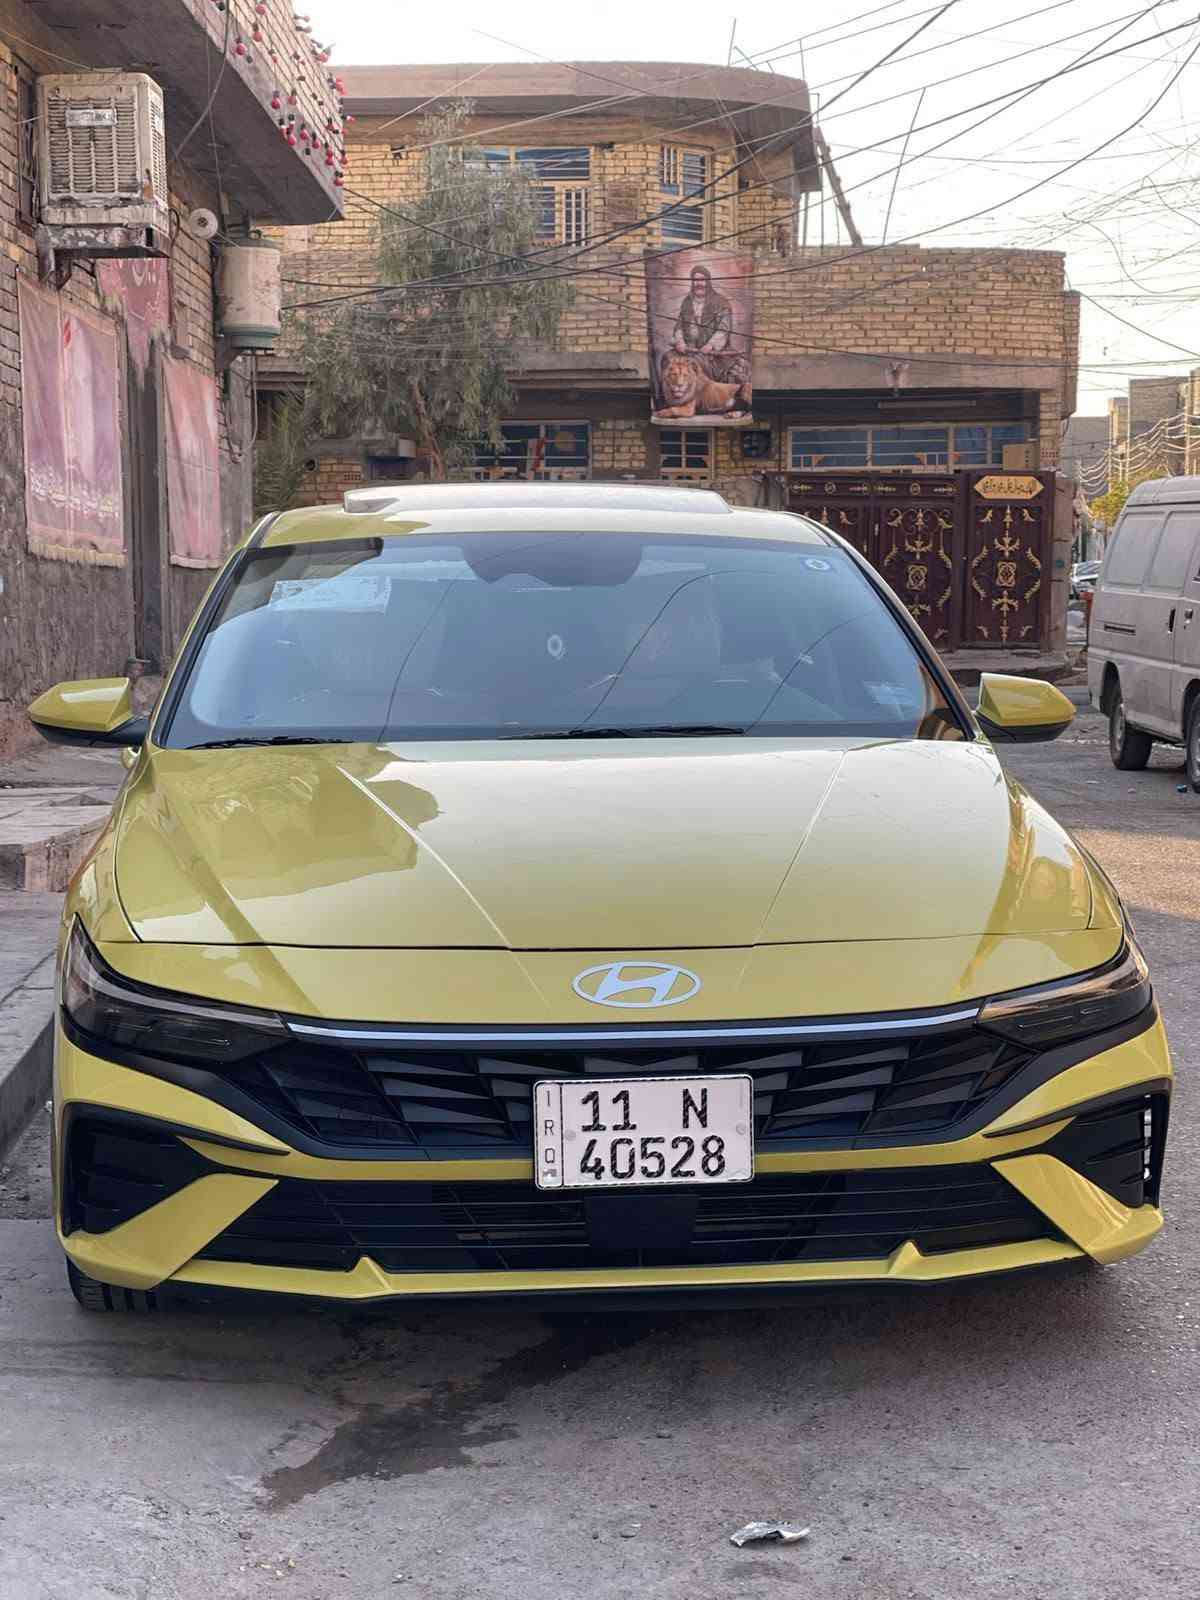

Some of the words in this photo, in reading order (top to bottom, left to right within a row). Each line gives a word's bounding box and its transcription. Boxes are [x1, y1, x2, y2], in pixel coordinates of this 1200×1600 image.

[581, 1090, 637, 1132] 11
[682, 1088, 708, 1129] N
[580, 1135, 726, 1180] 40528
